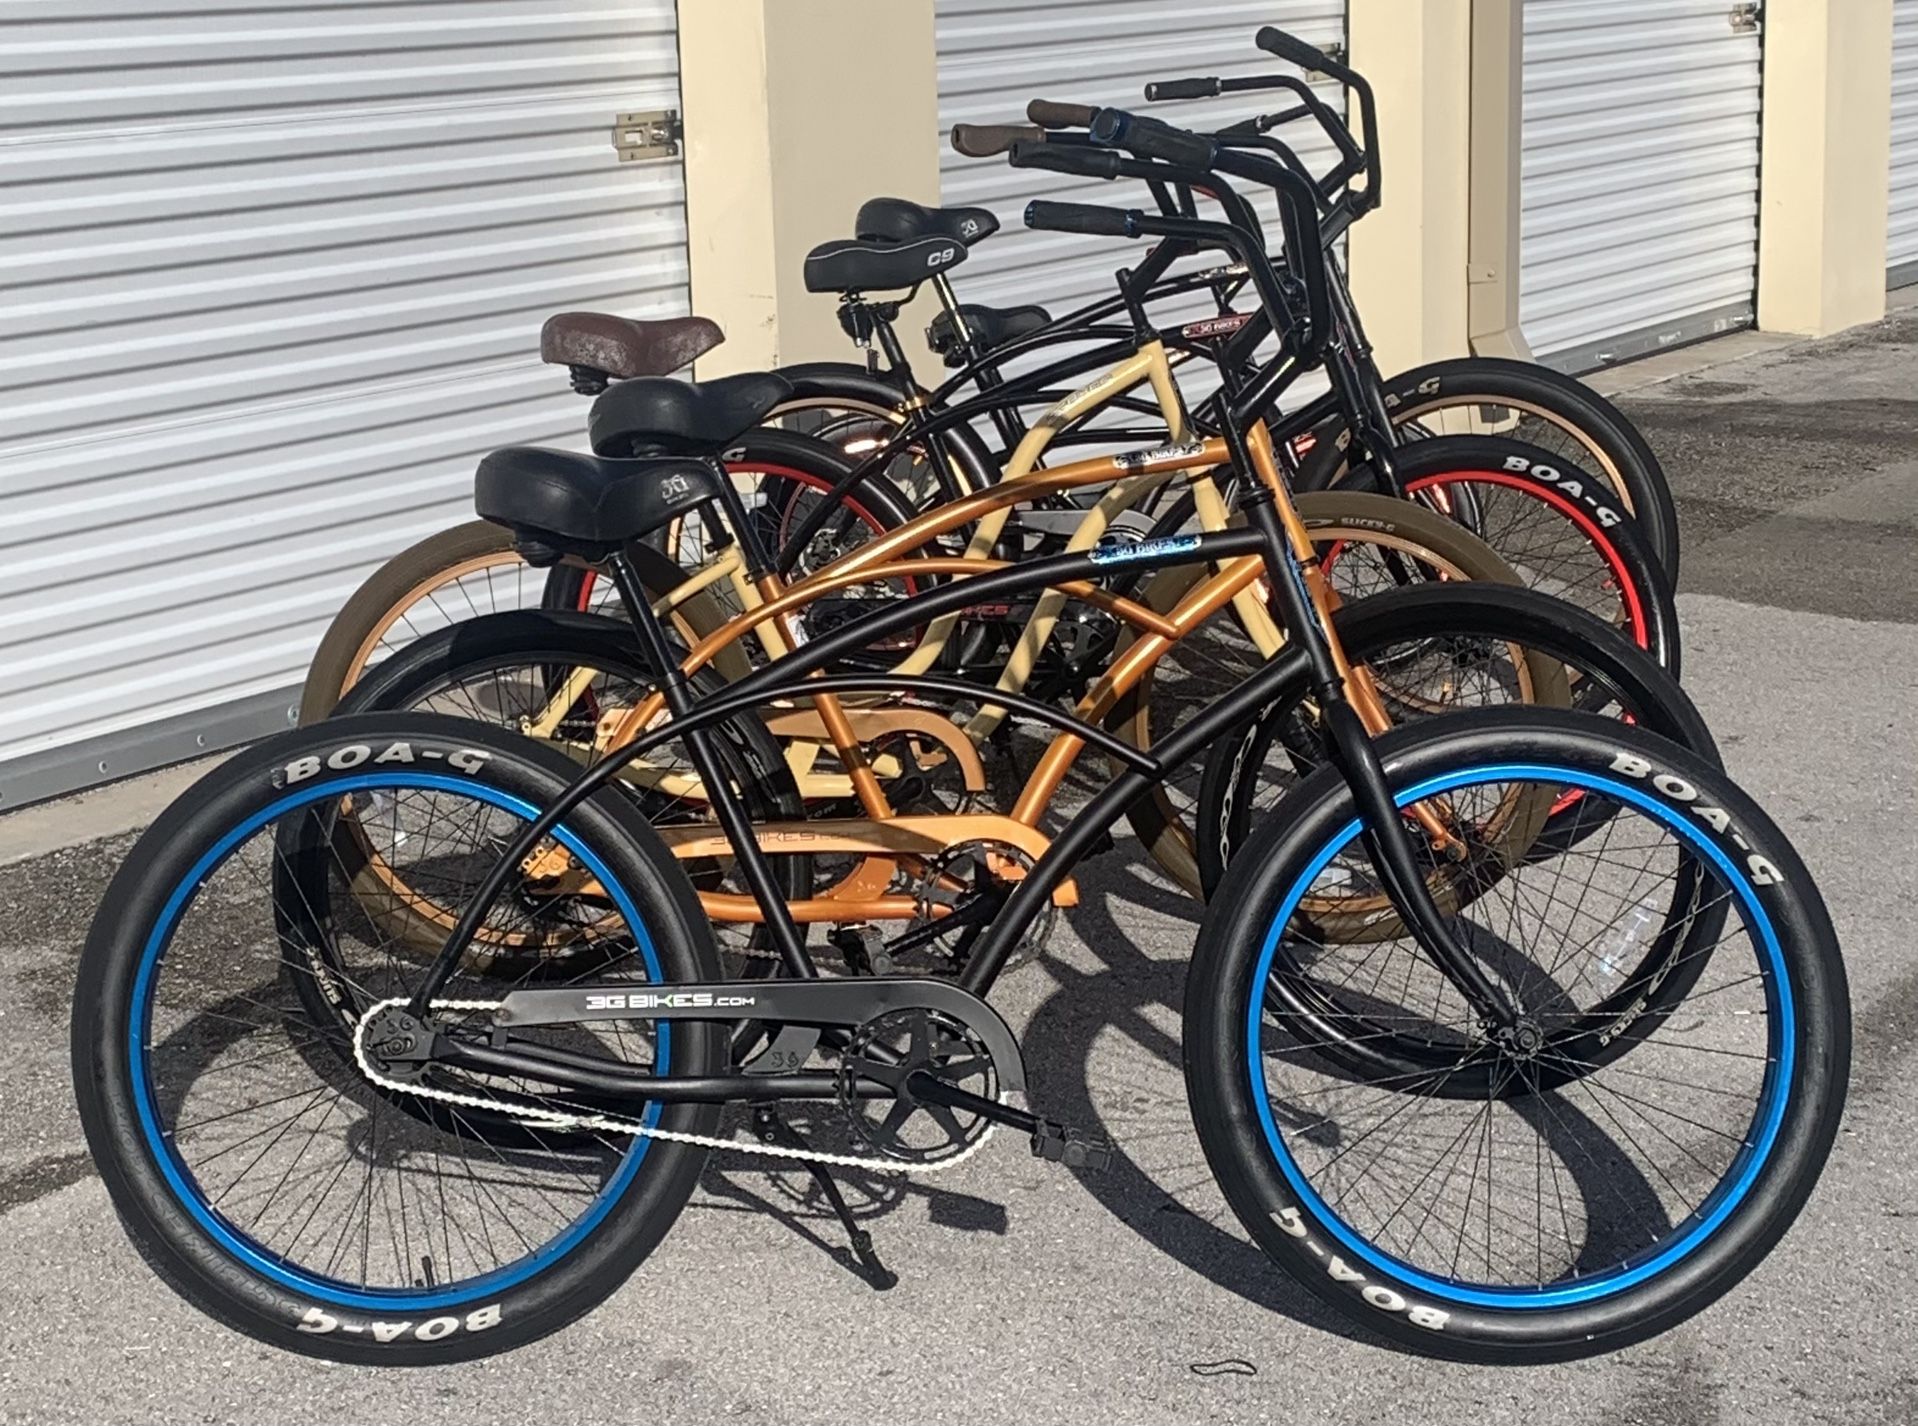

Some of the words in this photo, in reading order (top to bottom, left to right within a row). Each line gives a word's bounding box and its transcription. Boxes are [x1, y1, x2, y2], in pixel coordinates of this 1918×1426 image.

[1334, 376, 1441, 452] BA-G
[1502, 456, 1622, 528] BOA-G
[284, 742, 493, 785] BOA-G
[1609, 752, 1785, 886] BOA-G
[586, 995, 627, 1010] 3G
[629, 993, 756, 1009] BIKES.COM
[1269, 1206, 1451, 1331] BOA-G
[296, 1302, 503, 1343] BOA-G
